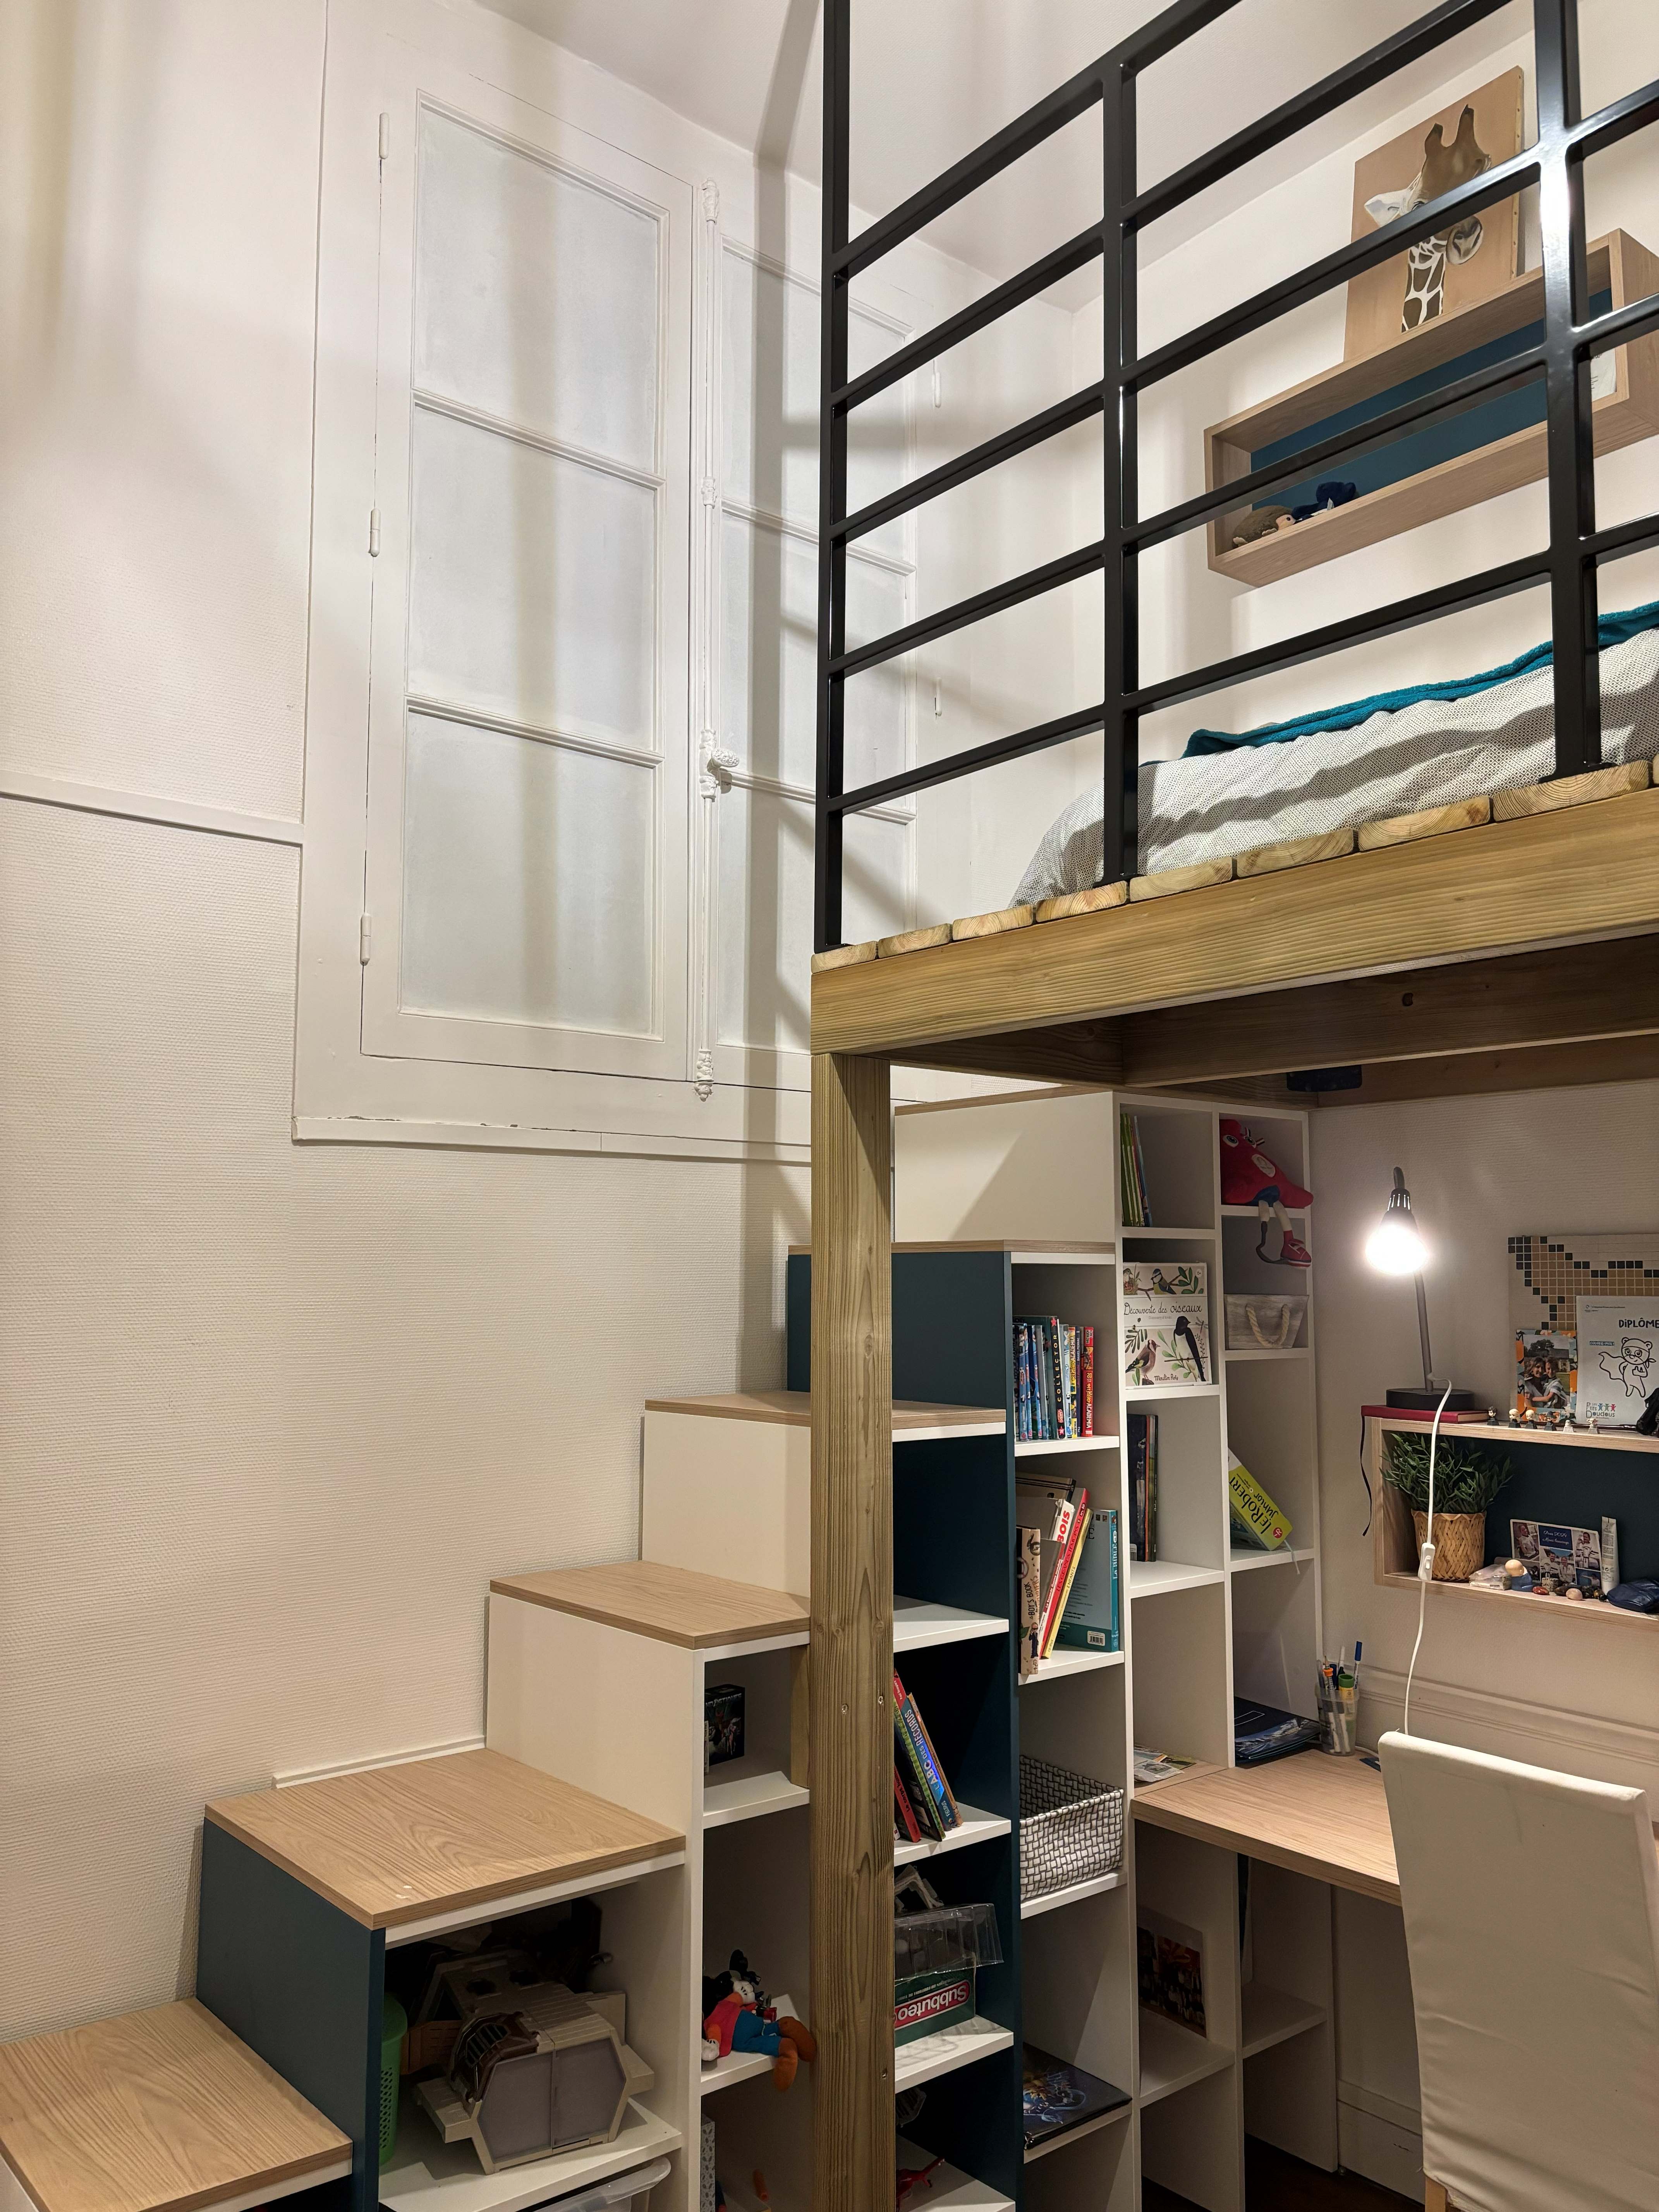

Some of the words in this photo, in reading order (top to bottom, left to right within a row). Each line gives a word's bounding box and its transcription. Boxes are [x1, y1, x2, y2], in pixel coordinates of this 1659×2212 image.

[1158, 1302, 1167, 1313] des
[1170, 1302, 1202, 1313] oiseaux
[1053, 1334, 1061, 1402] COLLECTOR
[1057, 1510, 1070, 1542] BOIS
[1024, 1582, 1034, 1598] BOOK
[1066, 1566, 1076, 1588] ENFANTS
[905, 1709, 924, 1746] RECORDS
[898, 1985, 967, 2020] Subbuteo
